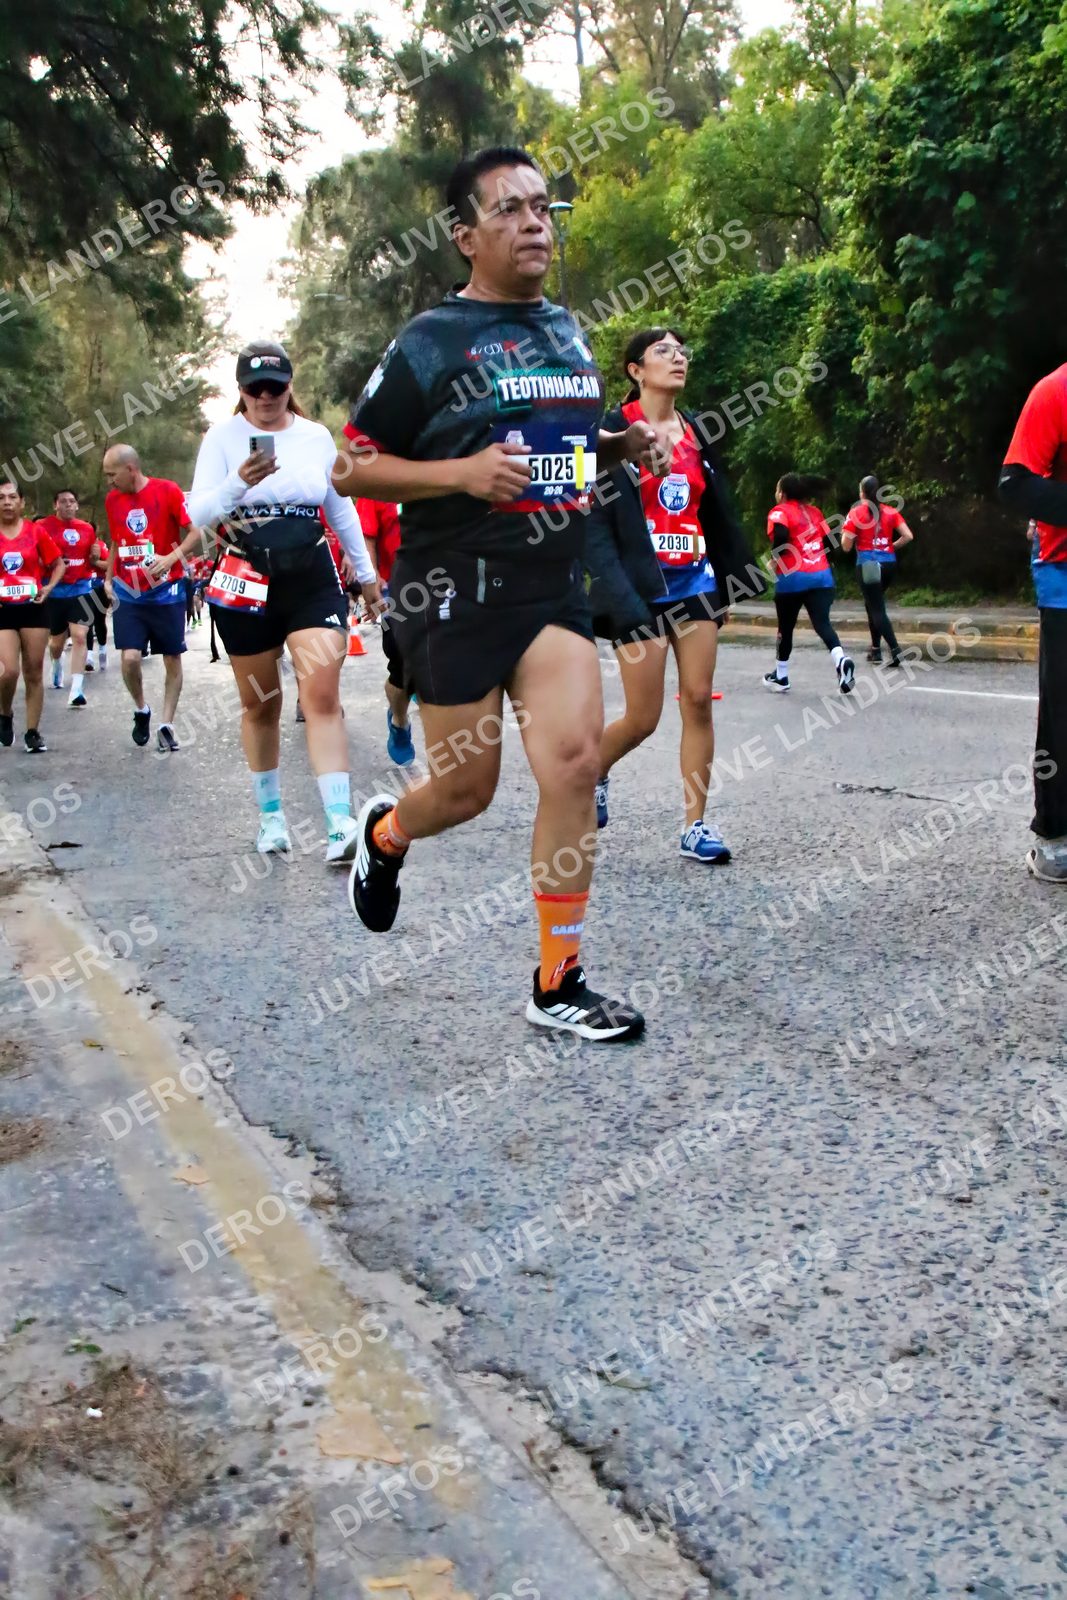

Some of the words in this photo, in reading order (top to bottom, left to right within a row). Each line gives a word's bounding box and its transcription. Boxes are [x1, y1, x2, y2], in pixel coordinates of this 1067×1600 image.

[498, 375, 600, 402] TEOTIHUACAN
[529, 456, 574, 482] 5025
[242, 506, 281, 516] NIKE
[284, 504, 315, 517] PRO
[659, 535, 689, 550] 2030
[6, 586, 25, 595] 3087
[220, 574, 246, 595] 2709
